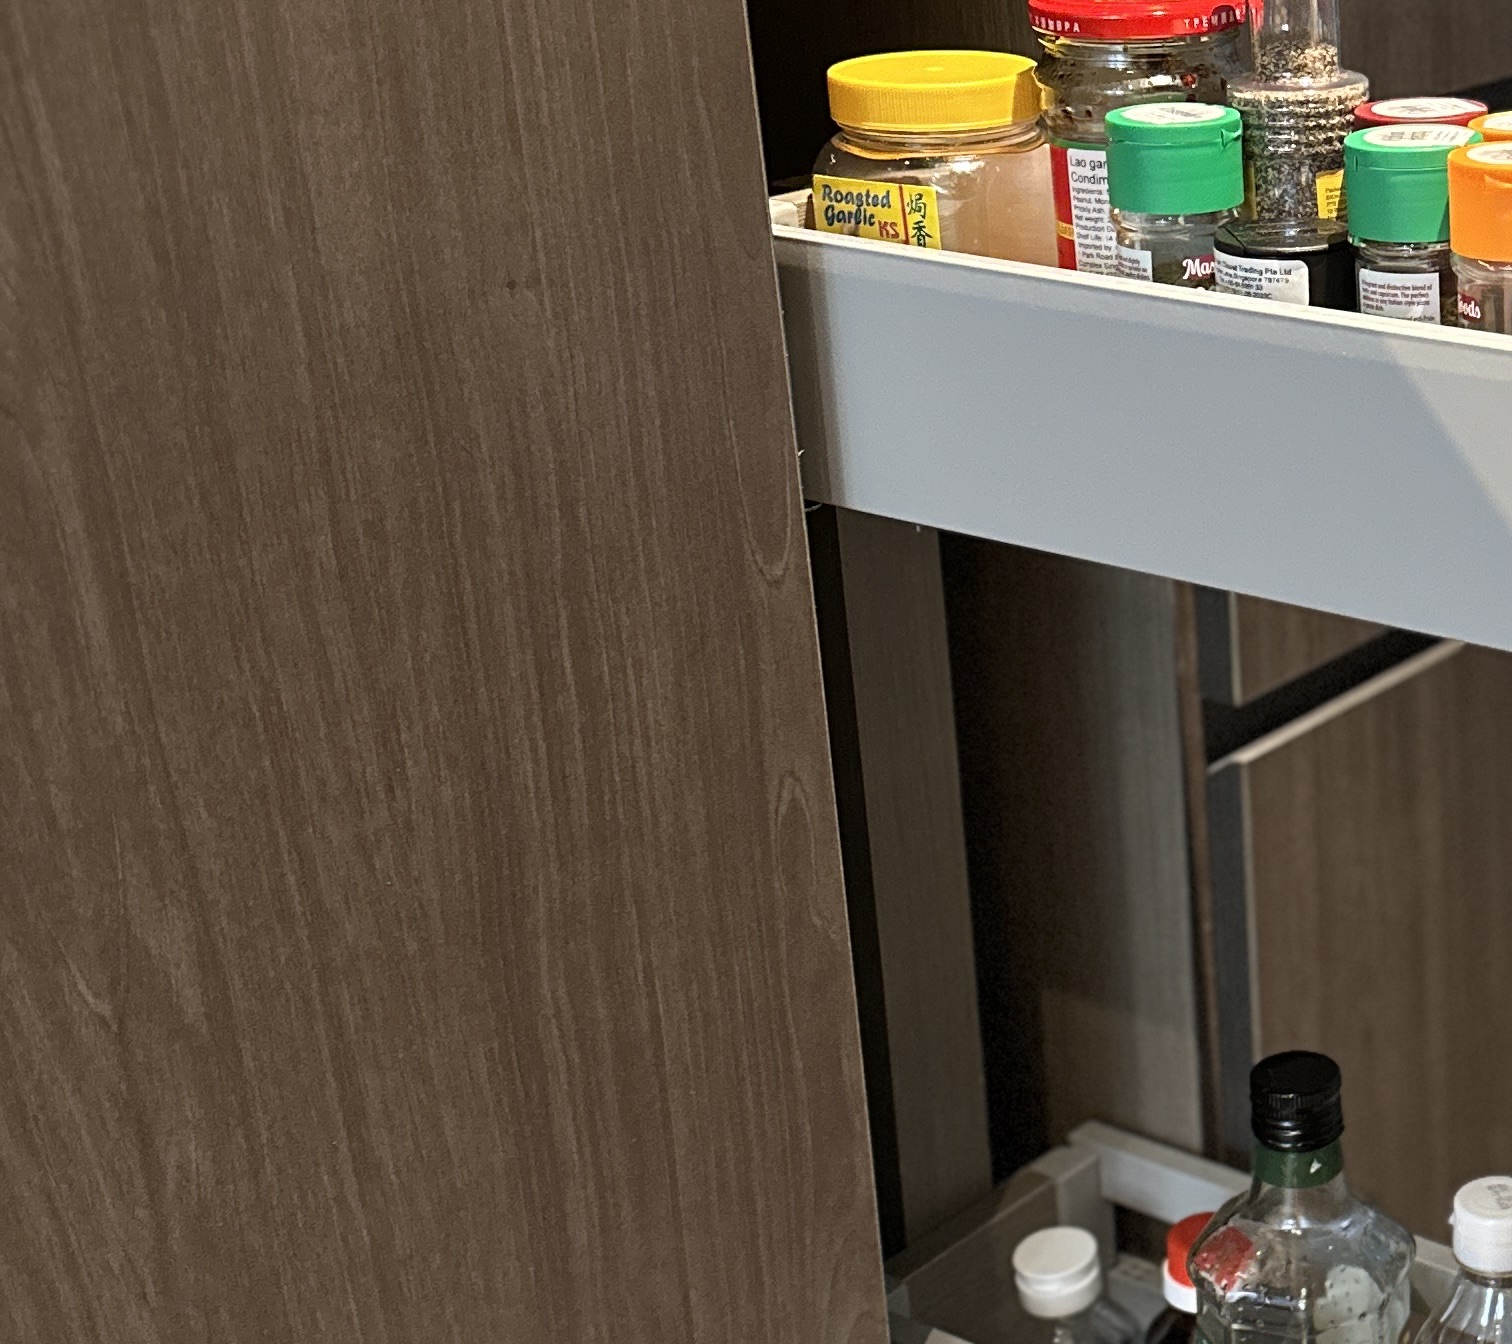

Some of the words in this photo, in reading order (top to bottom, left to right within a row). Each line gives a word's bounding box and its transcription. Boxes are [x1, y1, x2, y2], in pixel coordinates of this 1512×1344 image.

[1070, 156, 1087, 168] Lao
[821, 183, 892, 210] Roasted
[824, 204, 876, 228] Garlic
[877, 219, 900, 240] KS
